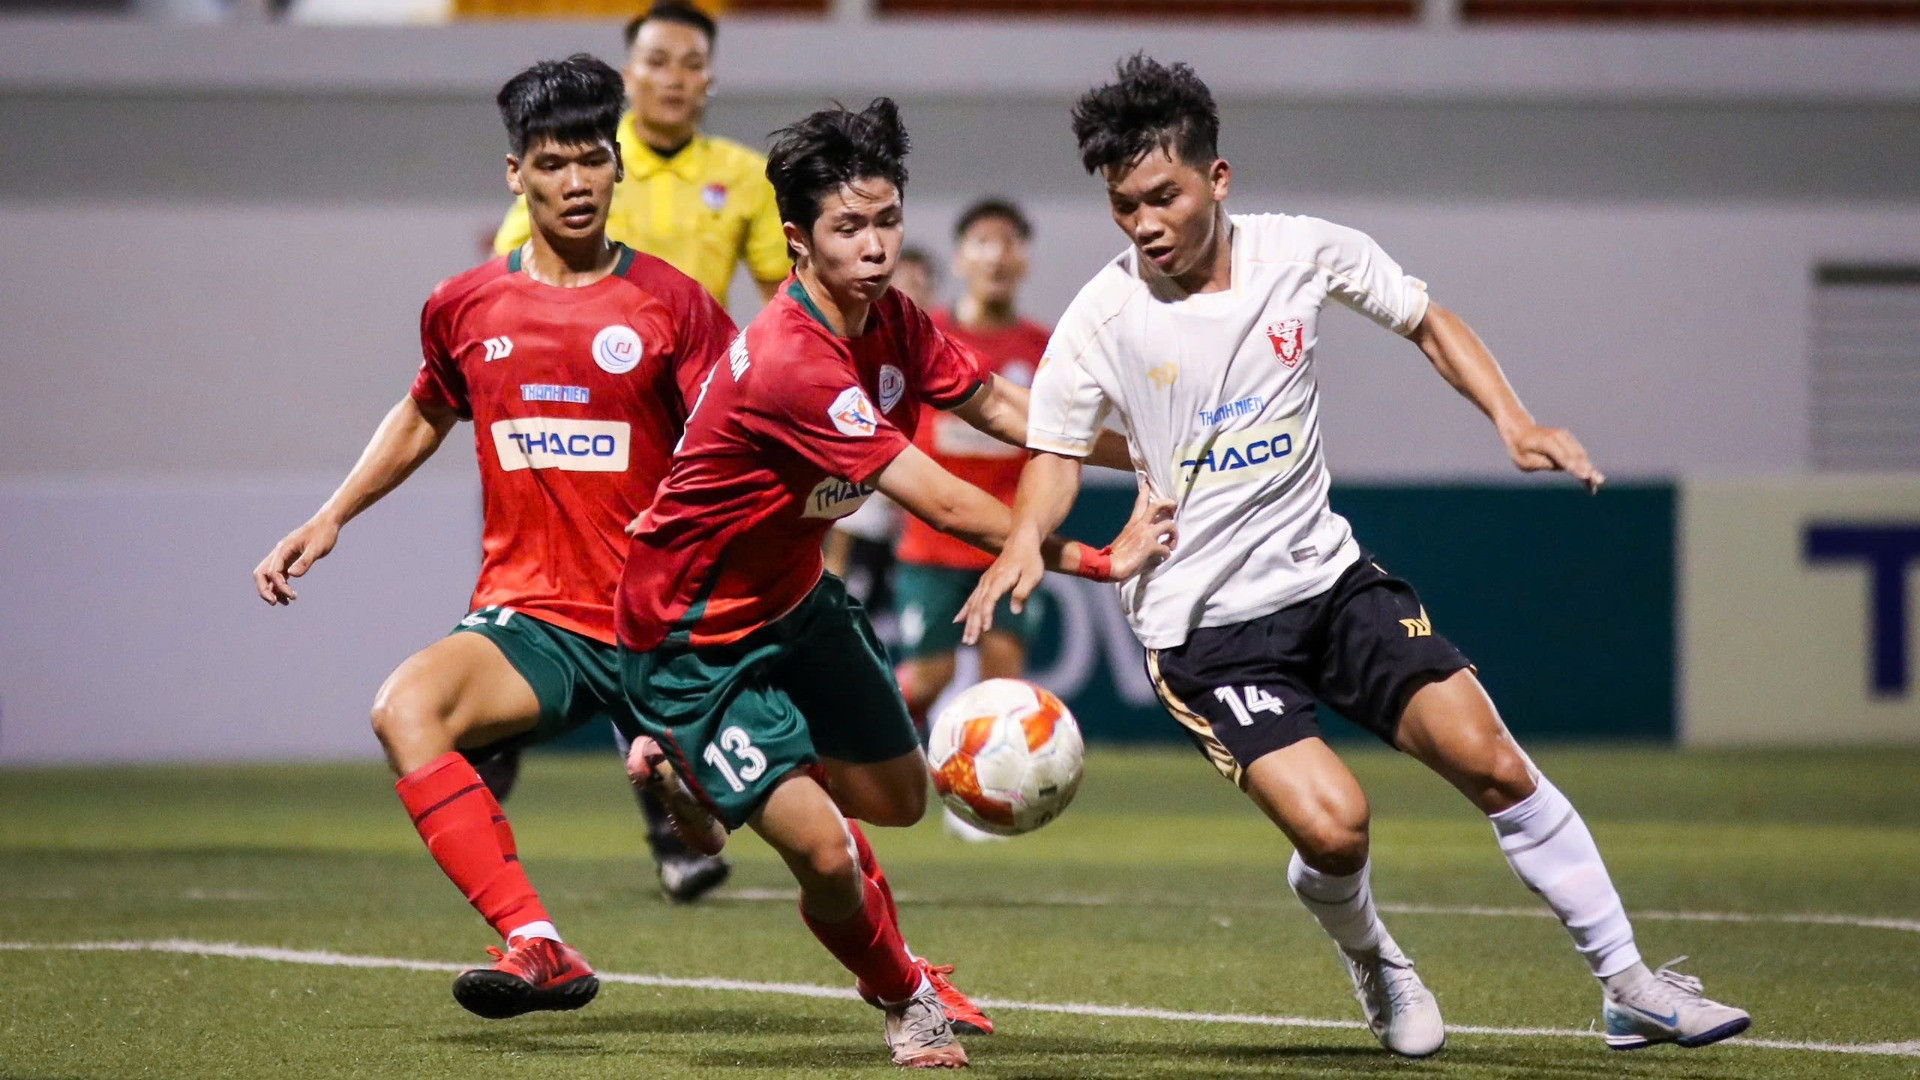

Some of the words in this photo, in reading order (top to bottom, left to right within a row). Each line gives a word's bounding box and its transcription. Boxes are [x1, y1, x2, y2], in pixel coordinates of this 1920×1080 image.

[508, 431, 615, 457] THACO
[815, 480, 877, 511] THAC
[1213, 685, 1285, 726] 14
[703, 725, 767, 792] 13
